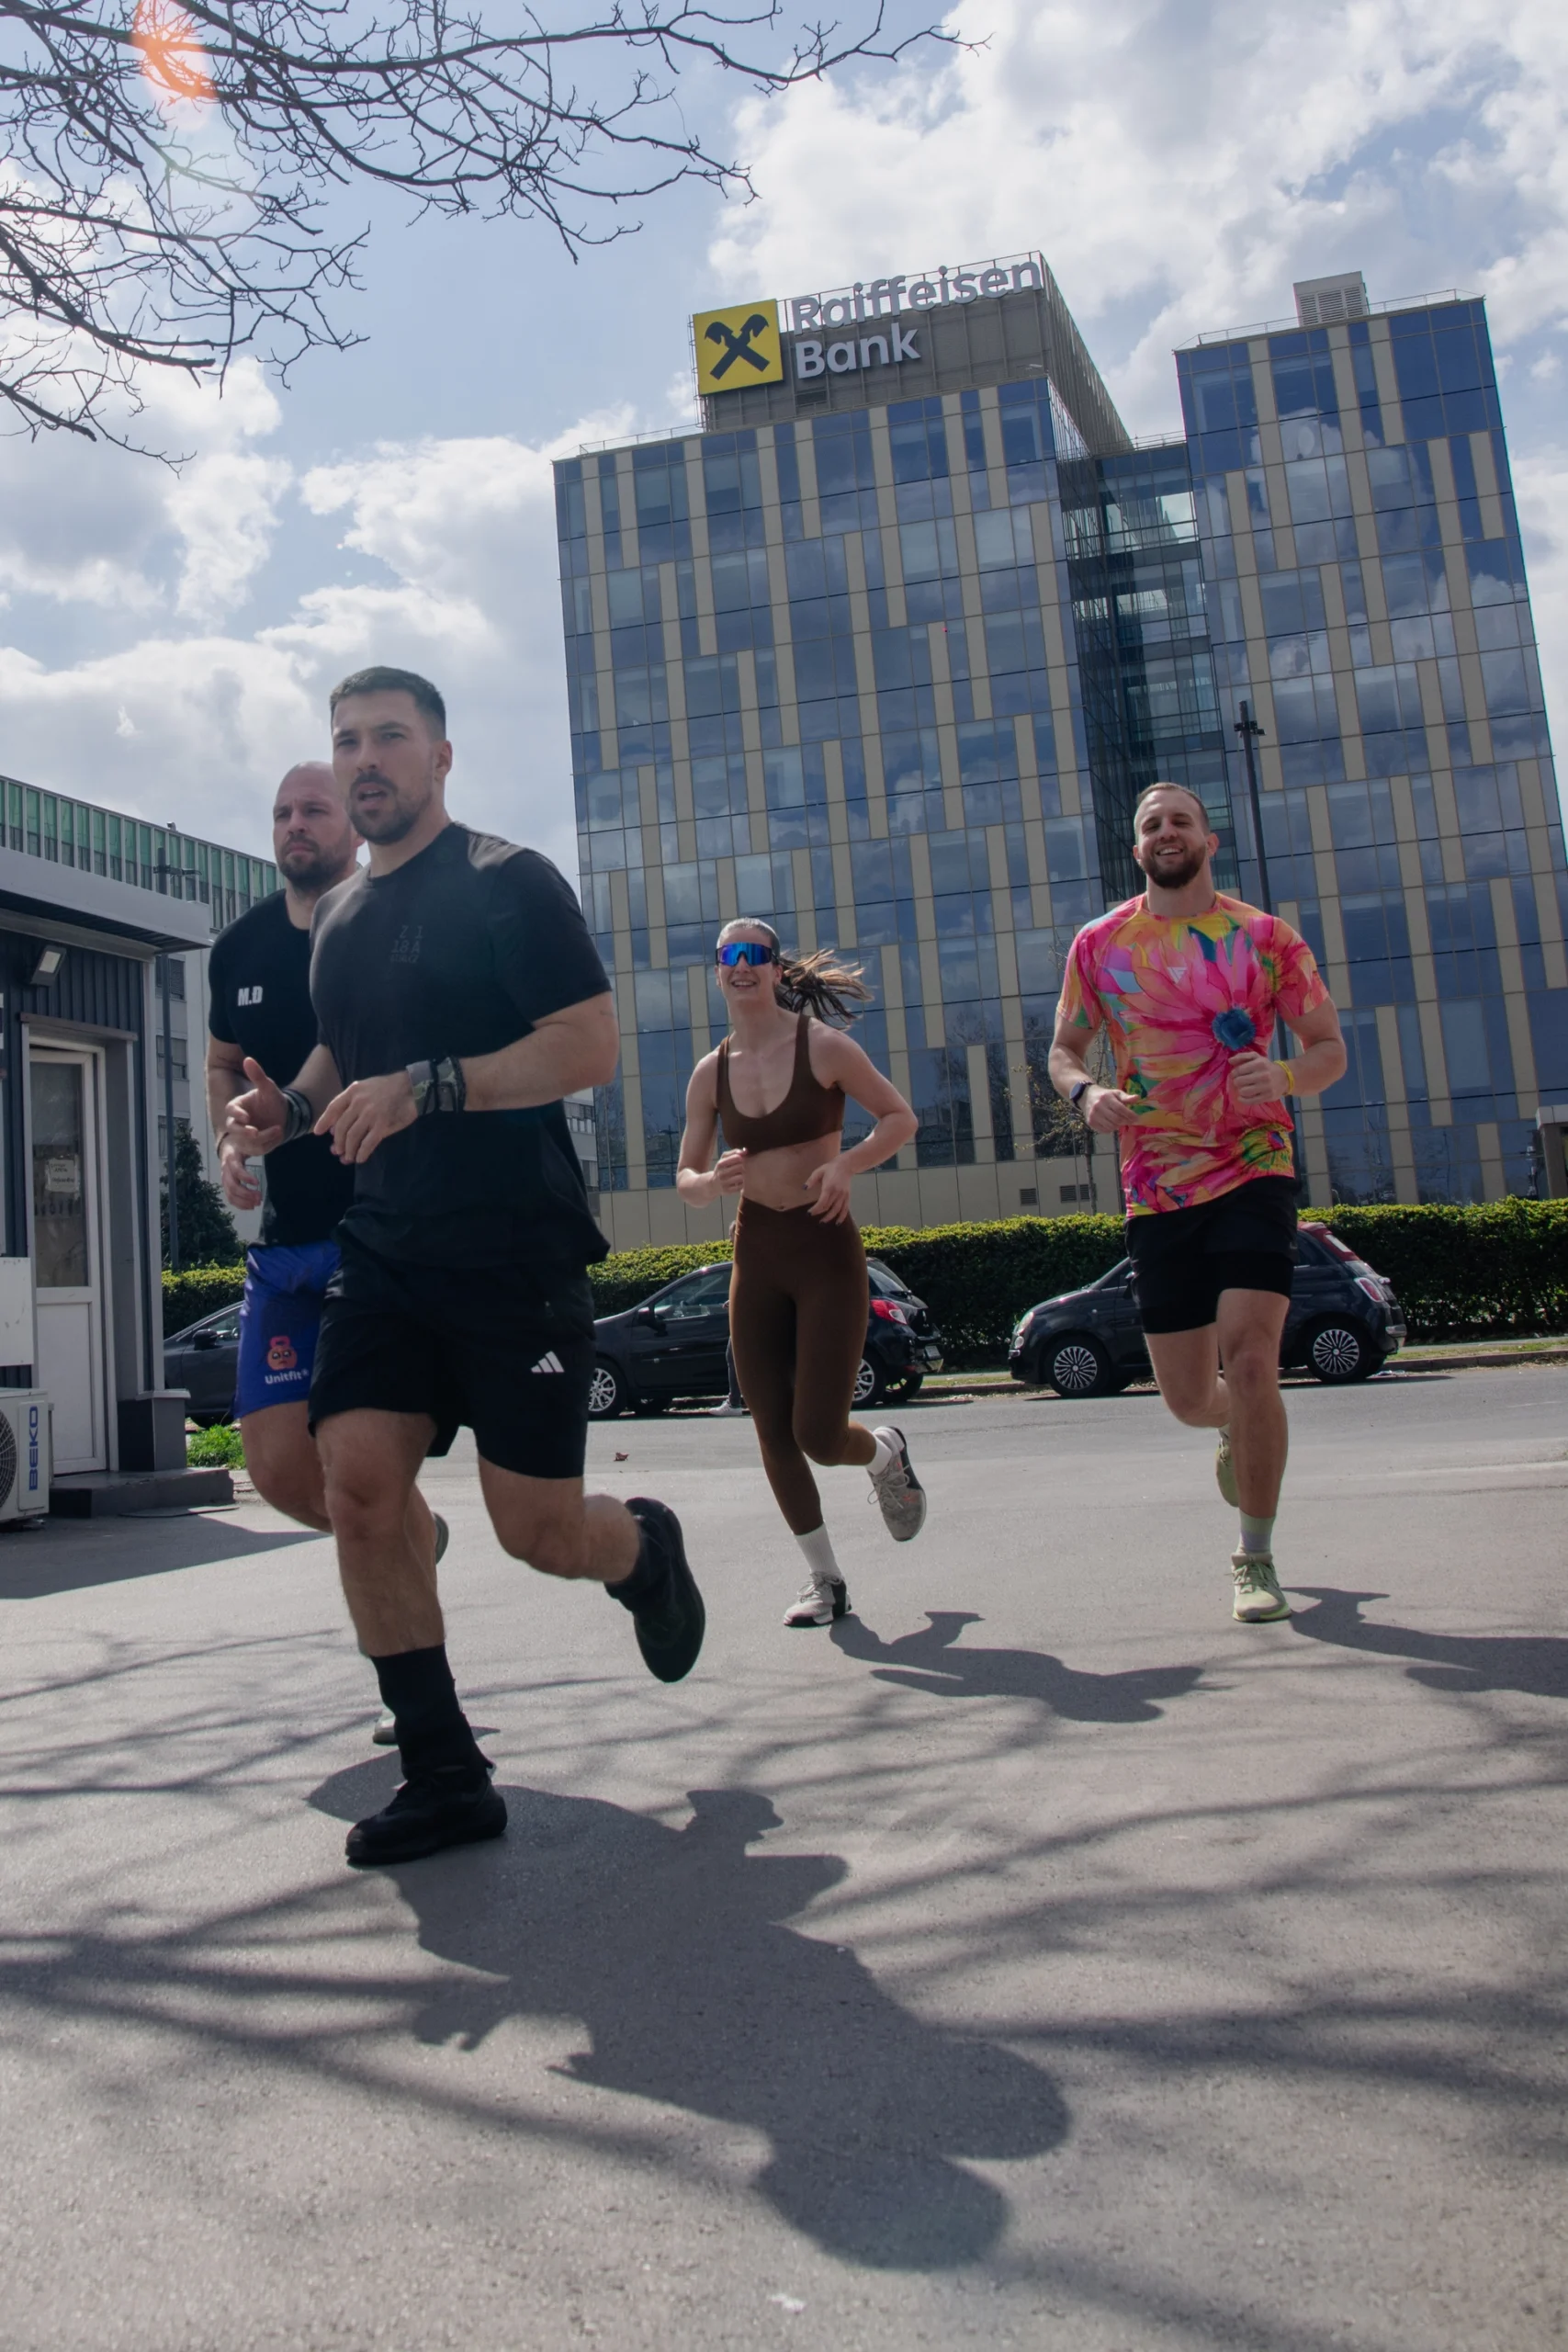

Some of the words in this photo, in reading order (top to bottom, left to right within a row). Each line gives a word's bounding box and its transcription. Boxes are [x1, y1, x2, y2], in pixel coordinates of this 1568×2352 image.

[791, 261, 1041, 335] Raiffeisen
[795, 322, 921, 379] Bank
[28, 1406, 39, 1490] BEKO
